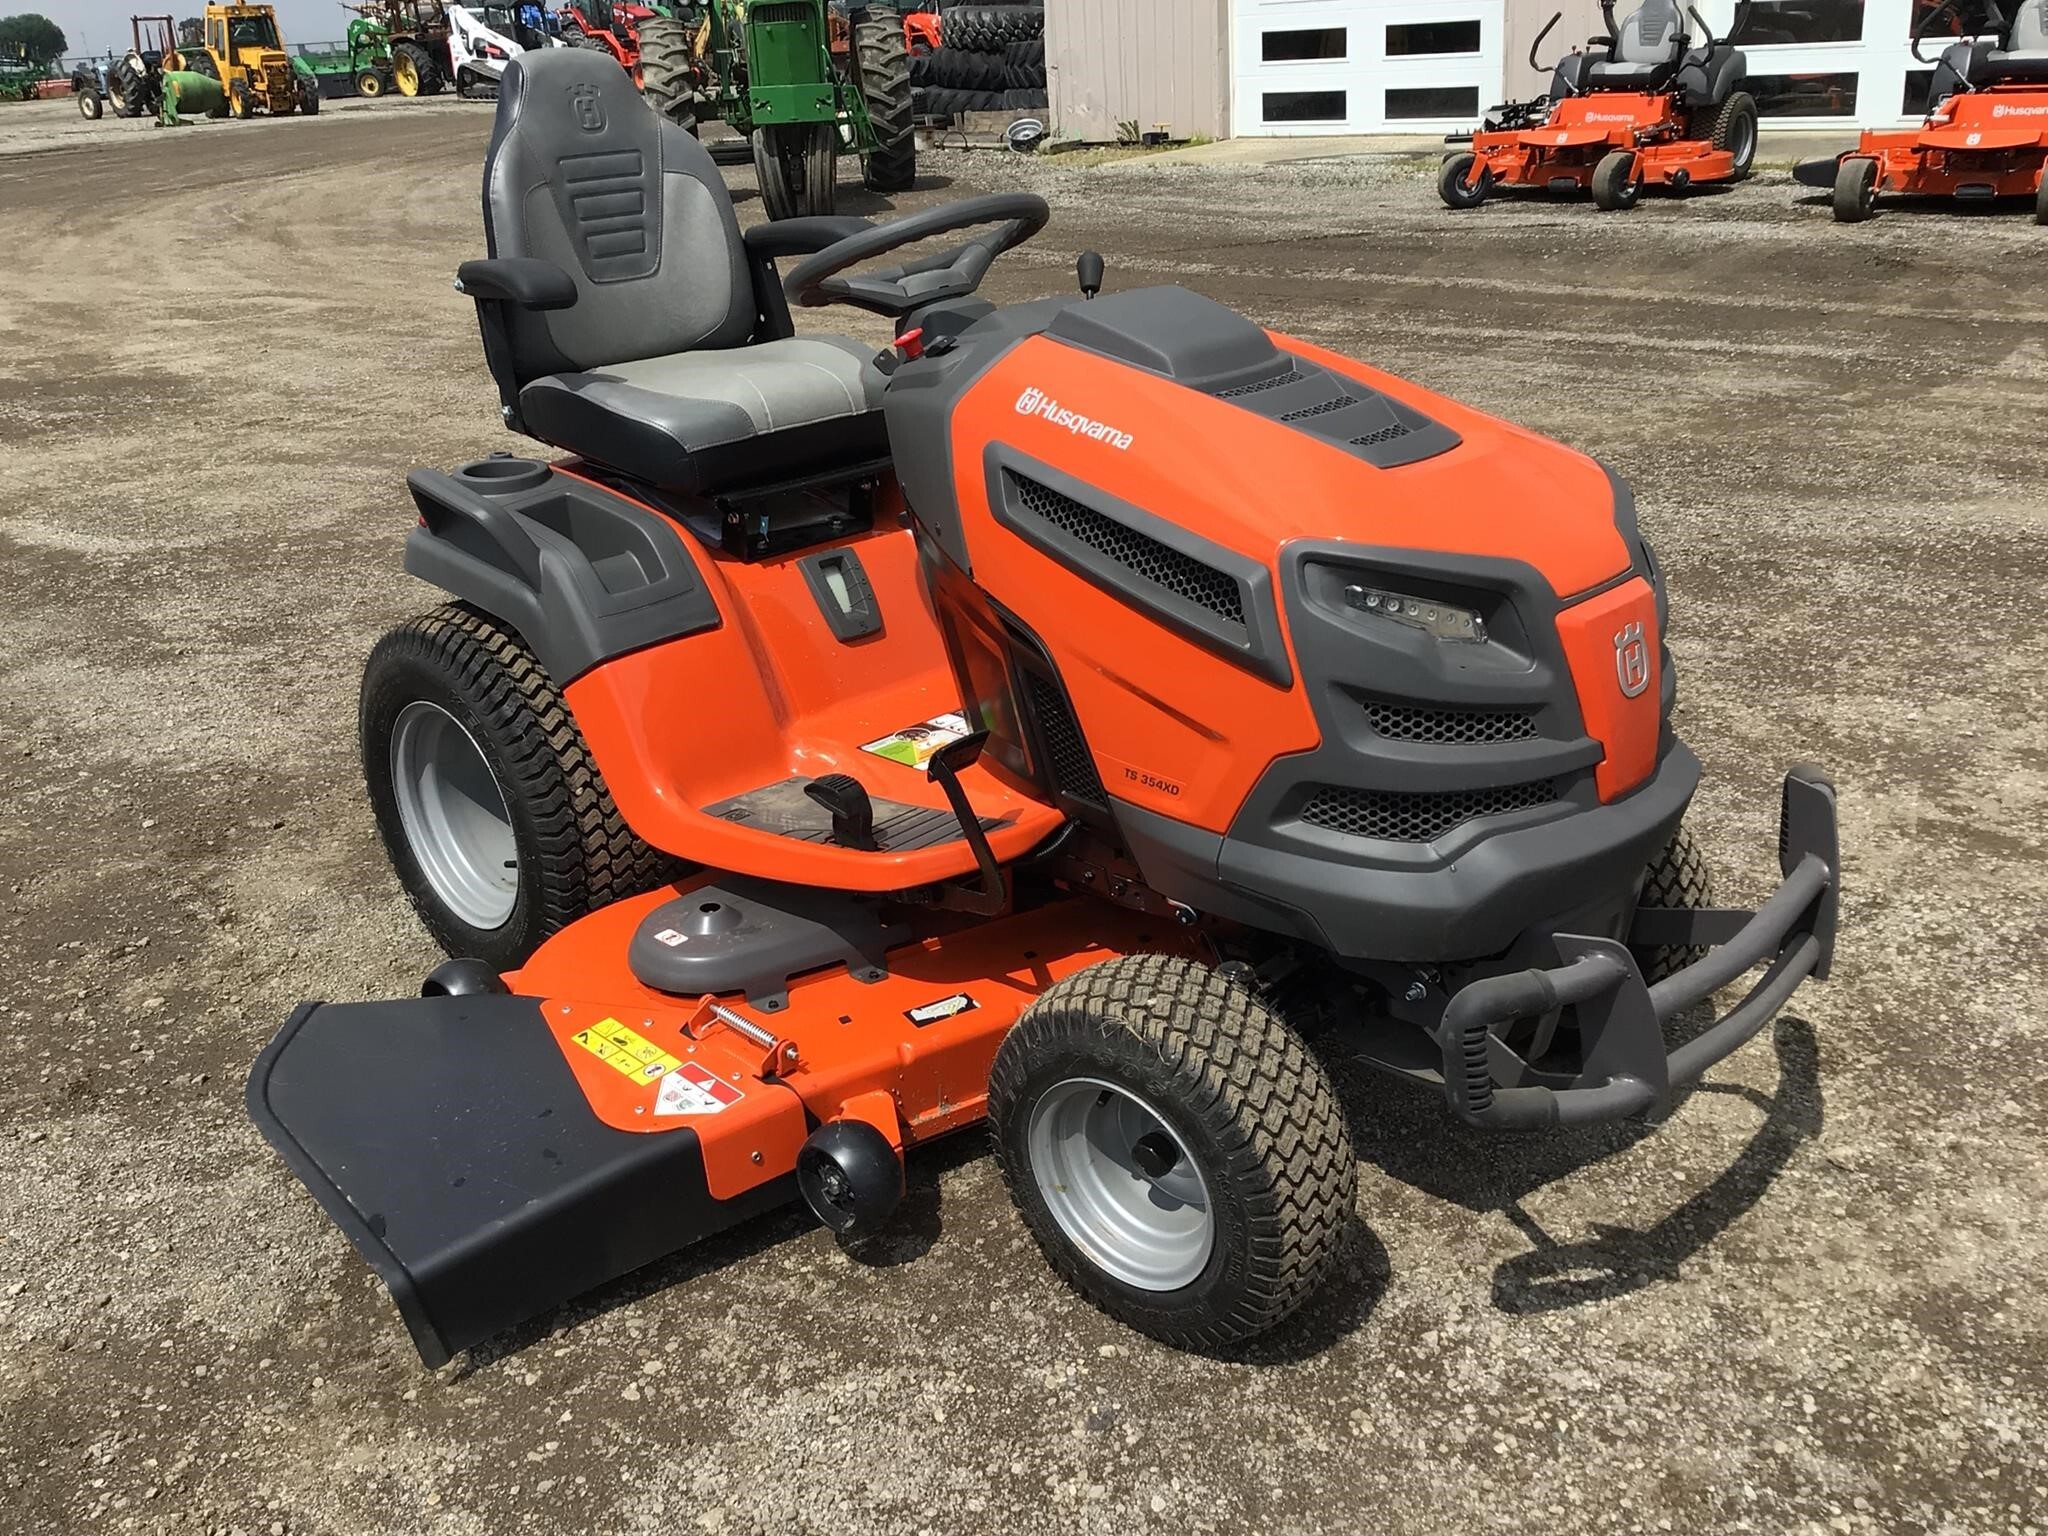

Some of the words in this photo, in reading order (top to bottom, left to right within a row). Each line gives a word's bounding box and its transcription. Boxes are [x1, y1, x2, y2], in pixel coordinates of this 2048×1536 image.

[1593, 112, 1635, 122] Husqvarna
[1034, 396, 1134, 451] Husqvarna
[1123, 767, 1139, 781] TS
[1140, 774, 1180, 796] 354XD
